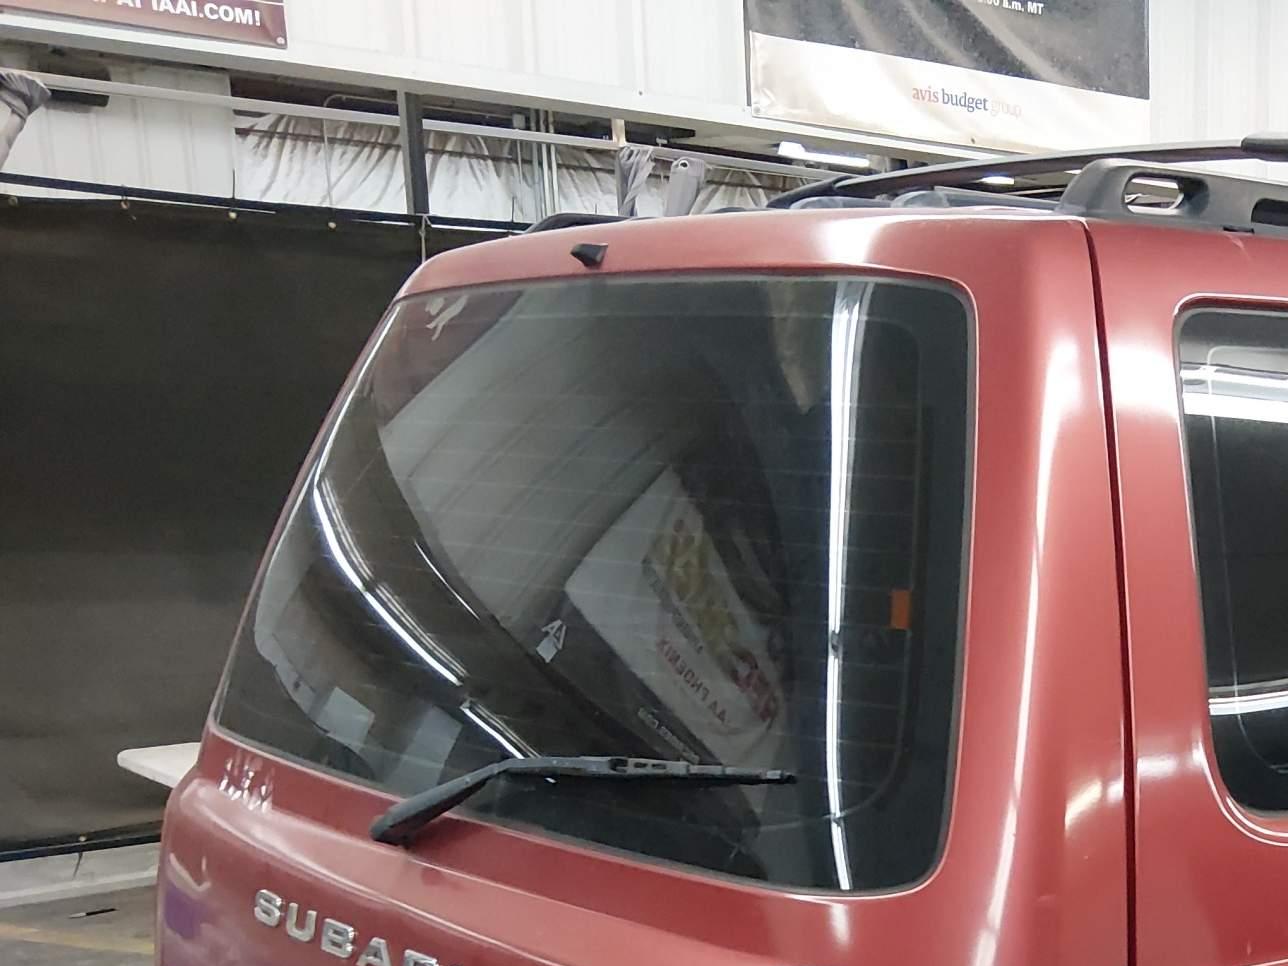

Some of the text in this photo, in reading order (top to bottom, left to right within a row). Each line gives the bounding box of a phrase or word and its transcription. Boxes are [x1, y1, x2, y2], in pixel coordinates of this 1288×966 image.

[151, 0, 261, 26] IAAI.COM!
[1027, 1, 1044, 15] MT
[912, 86, 939, 103] avis
[941, 89, 988, 113] budget
